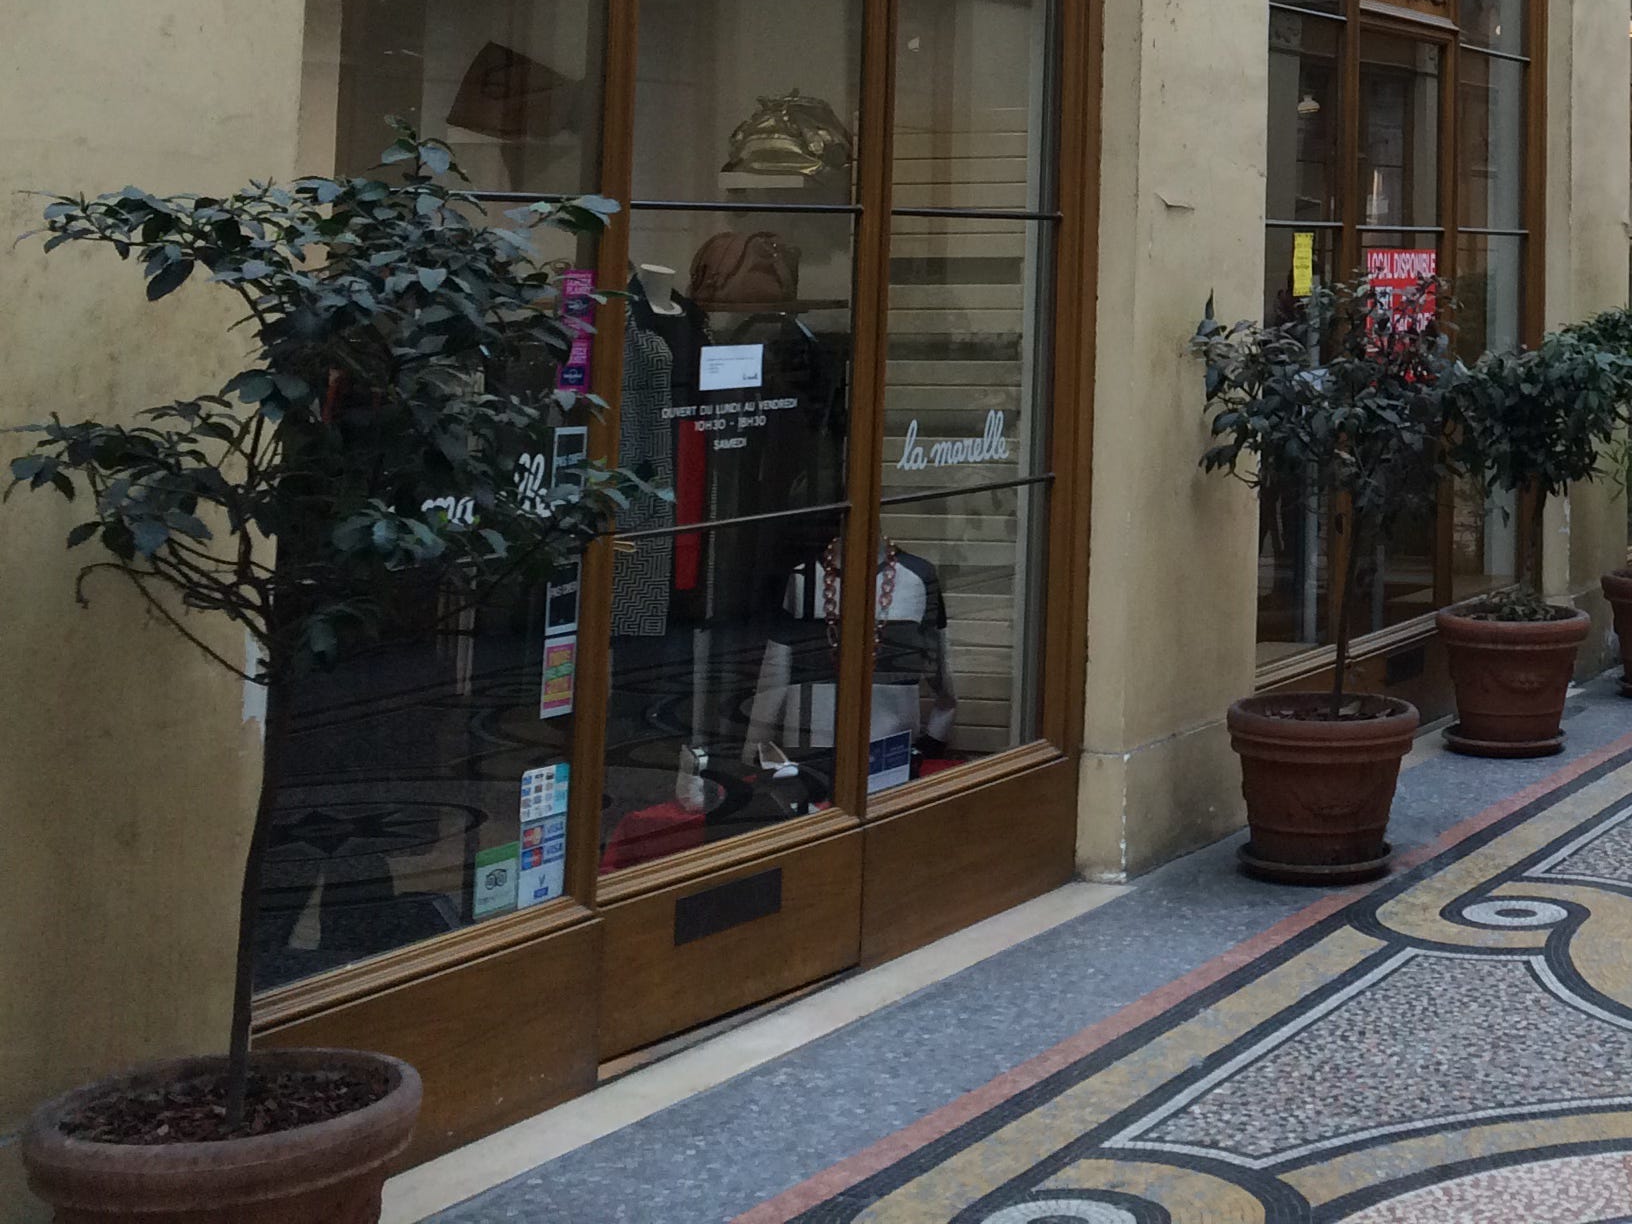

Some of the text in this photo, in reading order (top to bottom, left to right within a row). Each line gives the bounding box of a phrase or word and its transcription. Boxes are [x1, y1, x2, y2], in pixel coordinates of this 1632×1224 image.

[1367, 252, 1392, 279] LOCAL
[661, 398, 798, 419] OUVERT DU LUNDI AU VENDREDI
[694, 419, 726, 432] 10H30
[713, 437, 747, 451] SAMEDI
[896, 409, 1010, 470] la marelle
